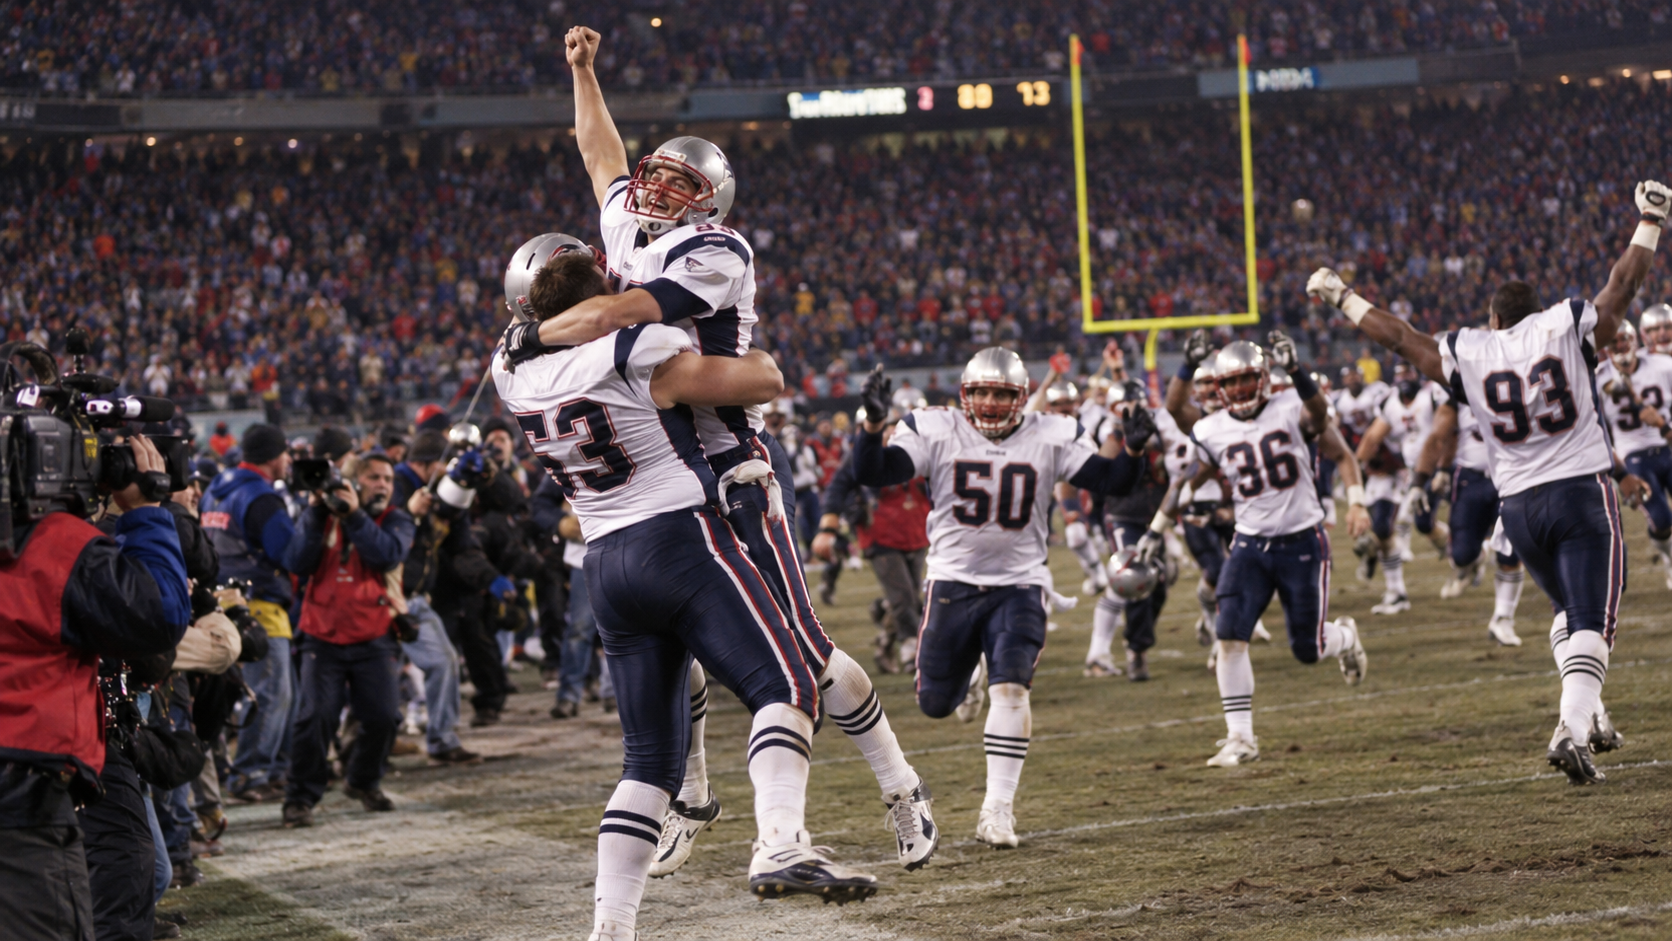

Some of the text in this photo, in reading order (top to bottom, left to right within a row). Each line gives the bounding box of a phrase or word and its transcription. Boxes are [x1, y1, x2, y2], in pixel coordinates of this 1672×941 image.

[1482, 354, 1579, 446] 93
[513, 396, 637, 500] 53
[1226, 429, 1300, 499] 36
[952, 458, 1038, 531] 50
